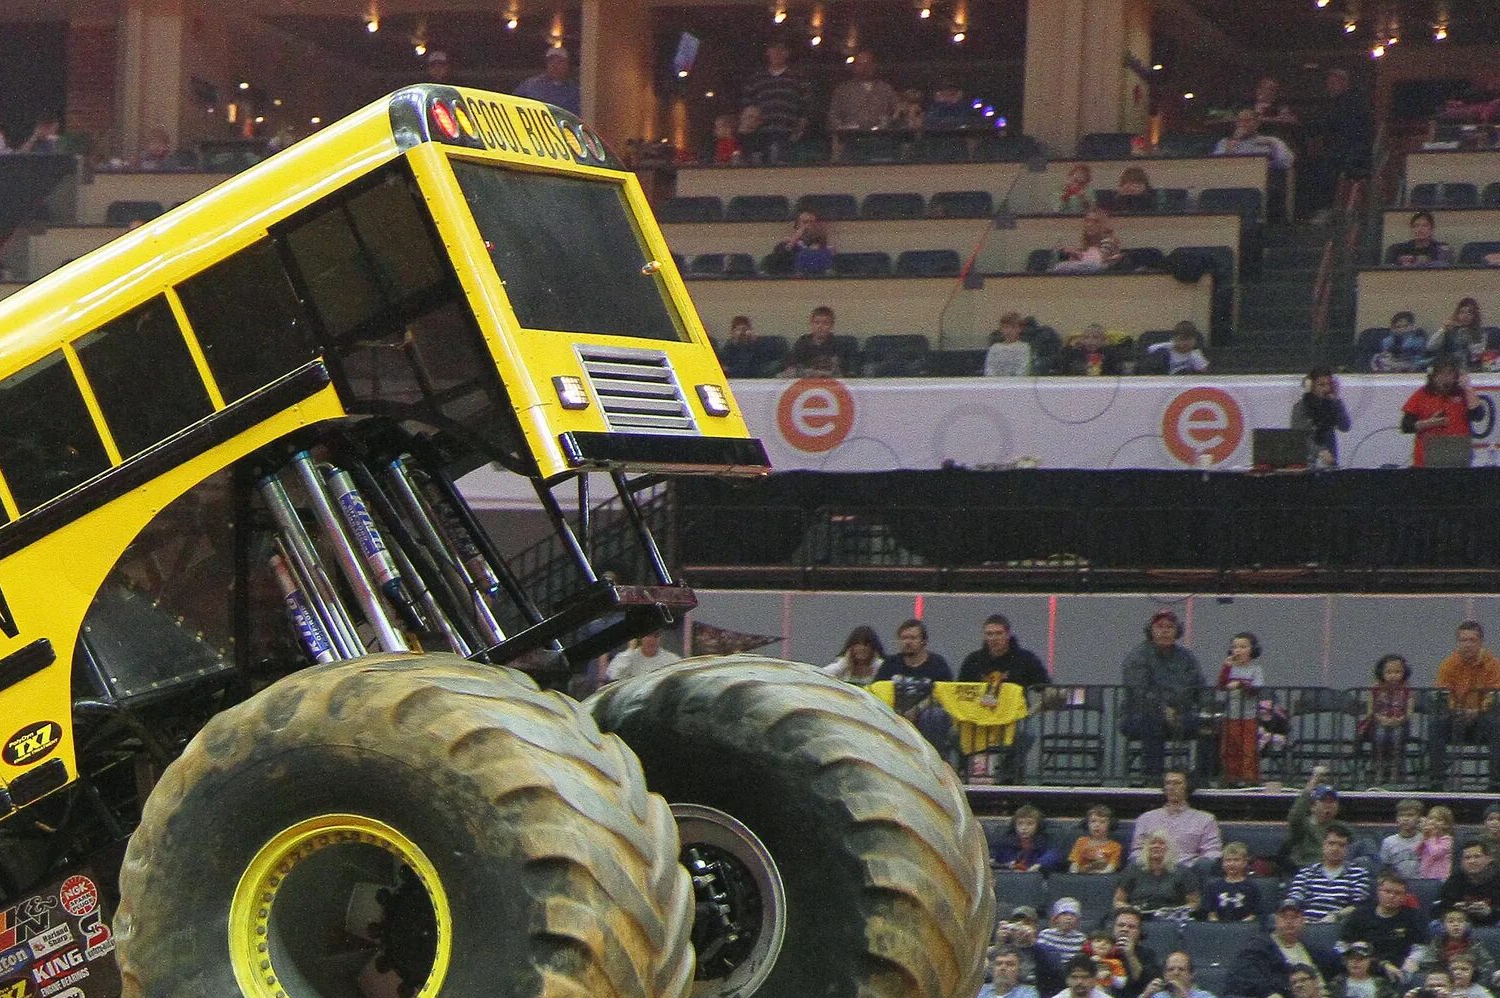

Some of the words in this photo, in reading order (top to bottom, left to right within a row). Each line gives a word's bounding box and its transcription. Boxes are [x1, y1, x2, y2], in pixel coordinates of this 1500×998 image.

[467, 97, 531, 155] COOL
[515, 105, 571, 161] BUS
[14, 723, 52, 758] TX7
[65, 882, 88, 900] NGK
[32, 948, 84, 984] KING
